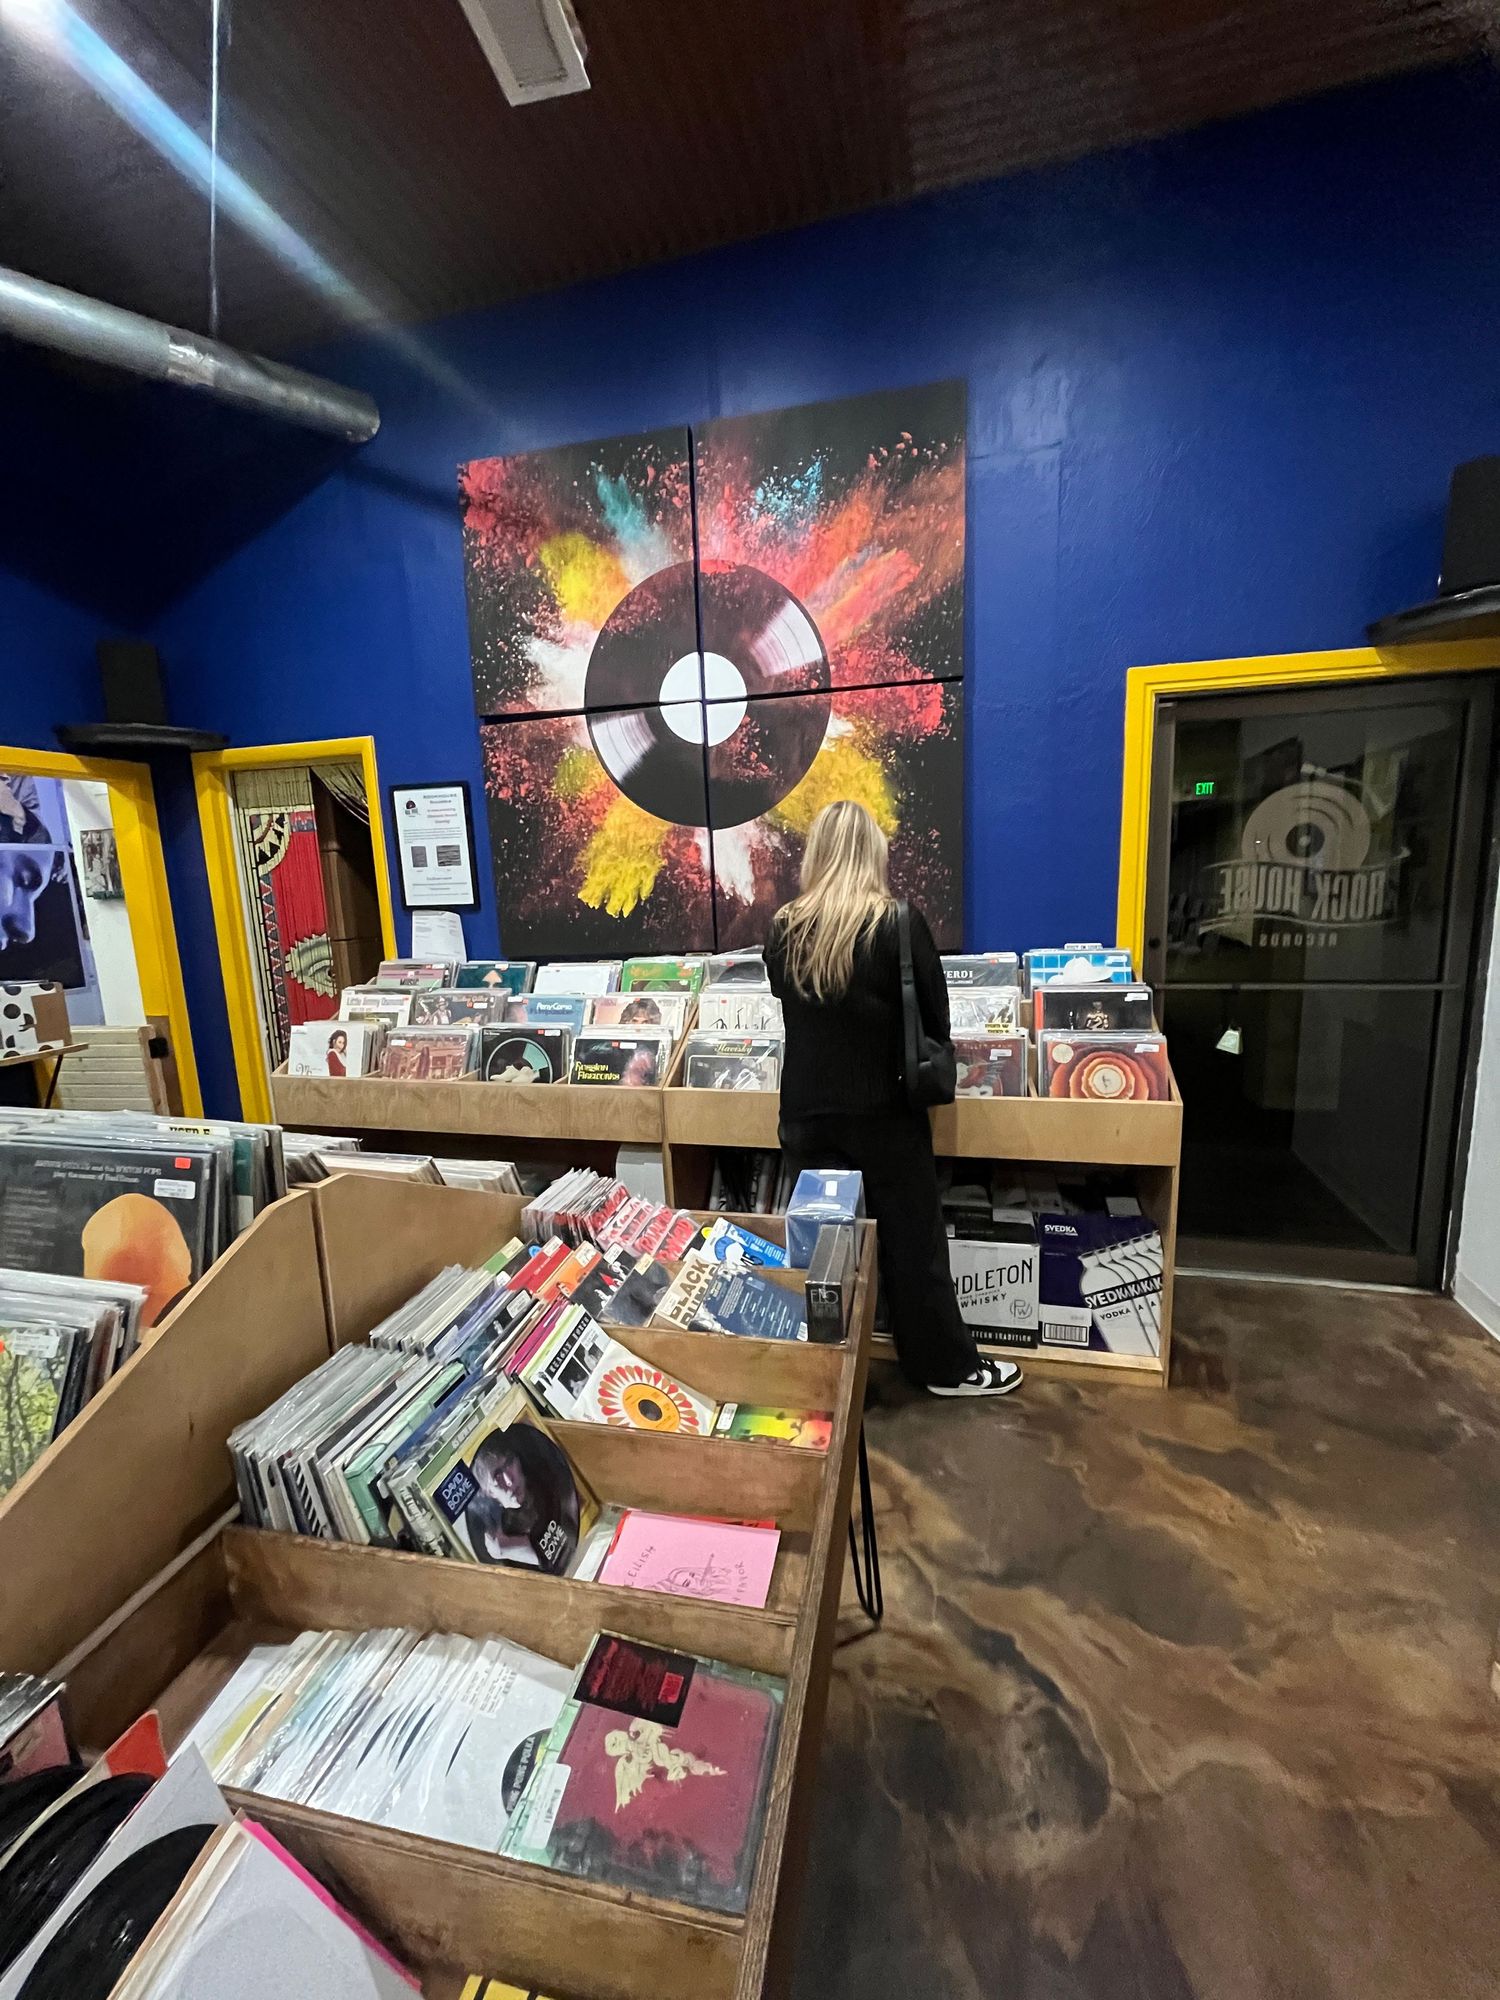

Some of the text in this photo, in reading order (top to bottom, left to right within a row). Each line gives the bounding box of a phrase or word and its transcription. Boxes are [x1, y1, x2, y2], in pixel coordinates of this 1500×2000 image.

[1195, 782, 1215, 795] EXIT
[1044, 1224, 1077, 1233] SVEDKA
[954, 1257, 1033, 1295] NDLETON
[960, 1293, 1007, 1308] WHISKY
[1100, 1307, 1131, 1320] VODKA
[442, 1472, 464, 1499] DAVID
[447, 1478, 472, 1510] BOWIE
[539, 1520, 557, 1549] DAVID
[545, 1526, 564, 1560] BOWIE
[628, 1545, 656, 1578] EILISH
[514, 1764, 526, 1790] PONG
[521, 1737, 535, 1765] POLKA
